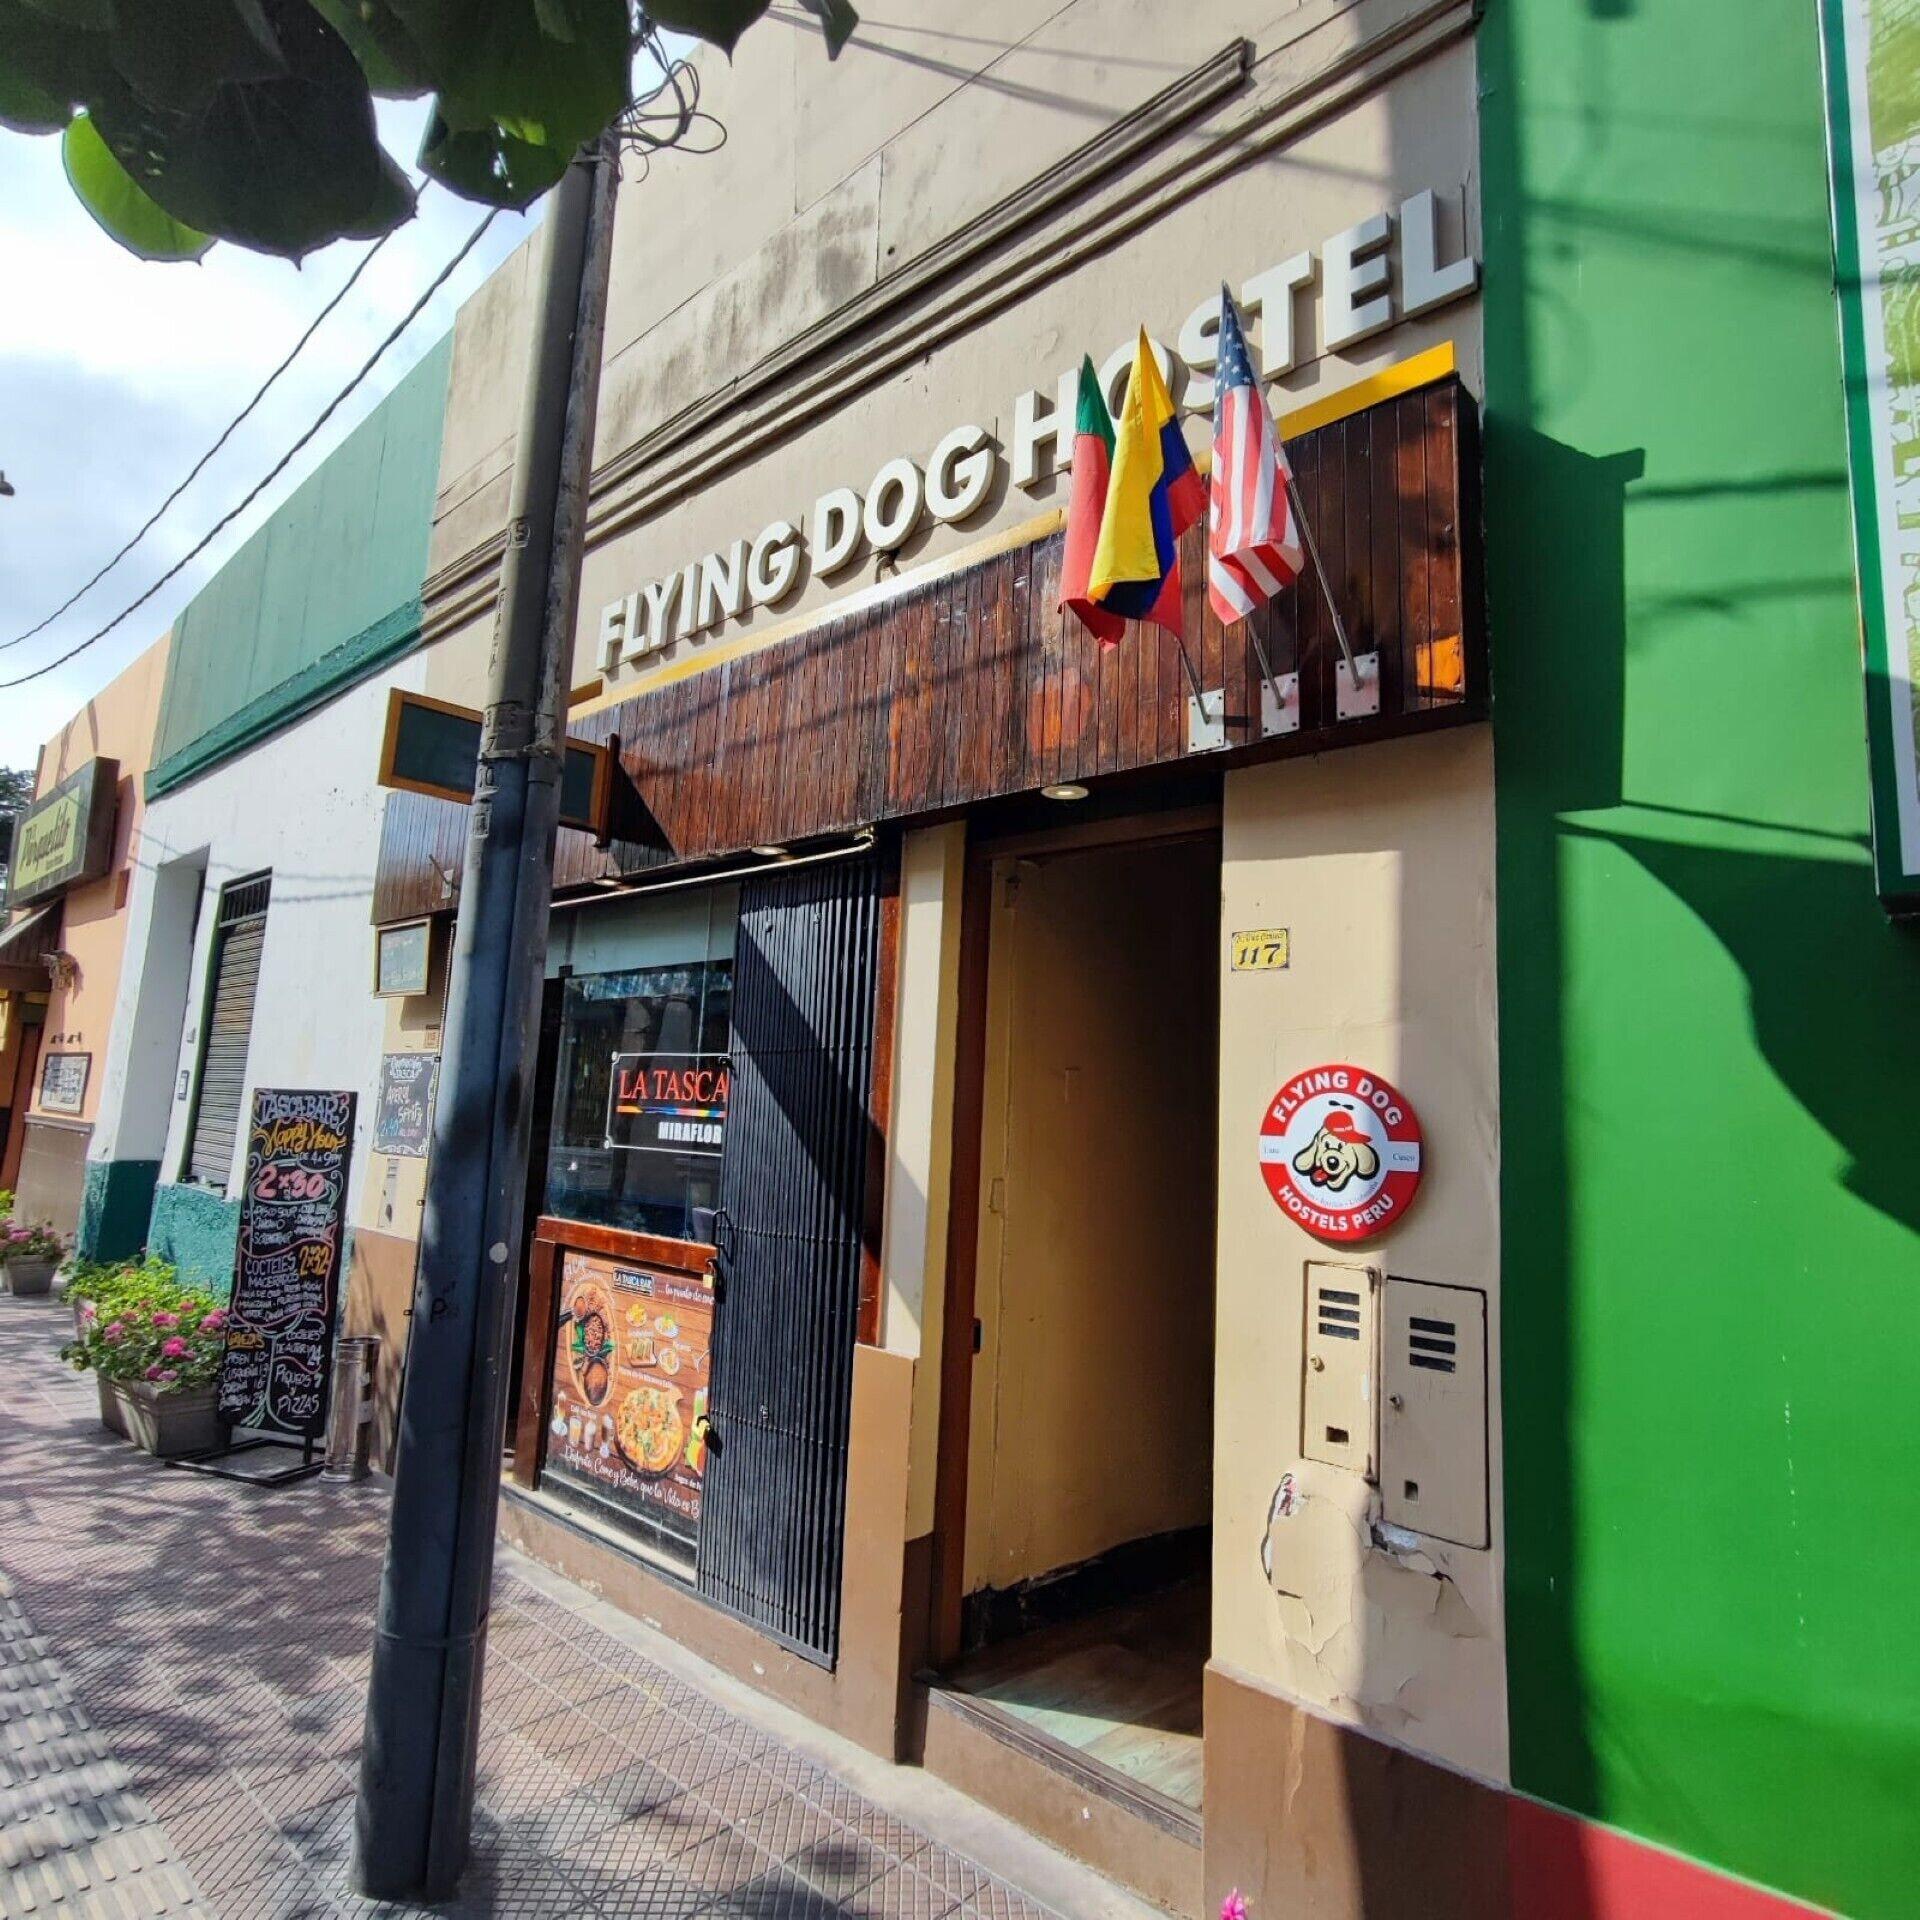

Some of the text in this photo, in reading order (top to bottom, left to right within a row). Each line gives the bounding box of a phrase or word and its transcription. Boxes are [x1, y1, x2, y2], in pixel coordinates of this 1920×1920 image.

[597, 513, 802, 672] FLYING
[812, 424, 994, 578] DOG
[1013, 188, 1480, 489] HOSTEL
[1238, 943, 1281, 967] 117
[617, 1069, 730, 1103] LA TASCA
[1272, 1071, 1403, 1126] FLYING DOG
[1278, 1185, 1350, 1232] HOSTELS
[1352, 1193, 1395, 1230] PERU
